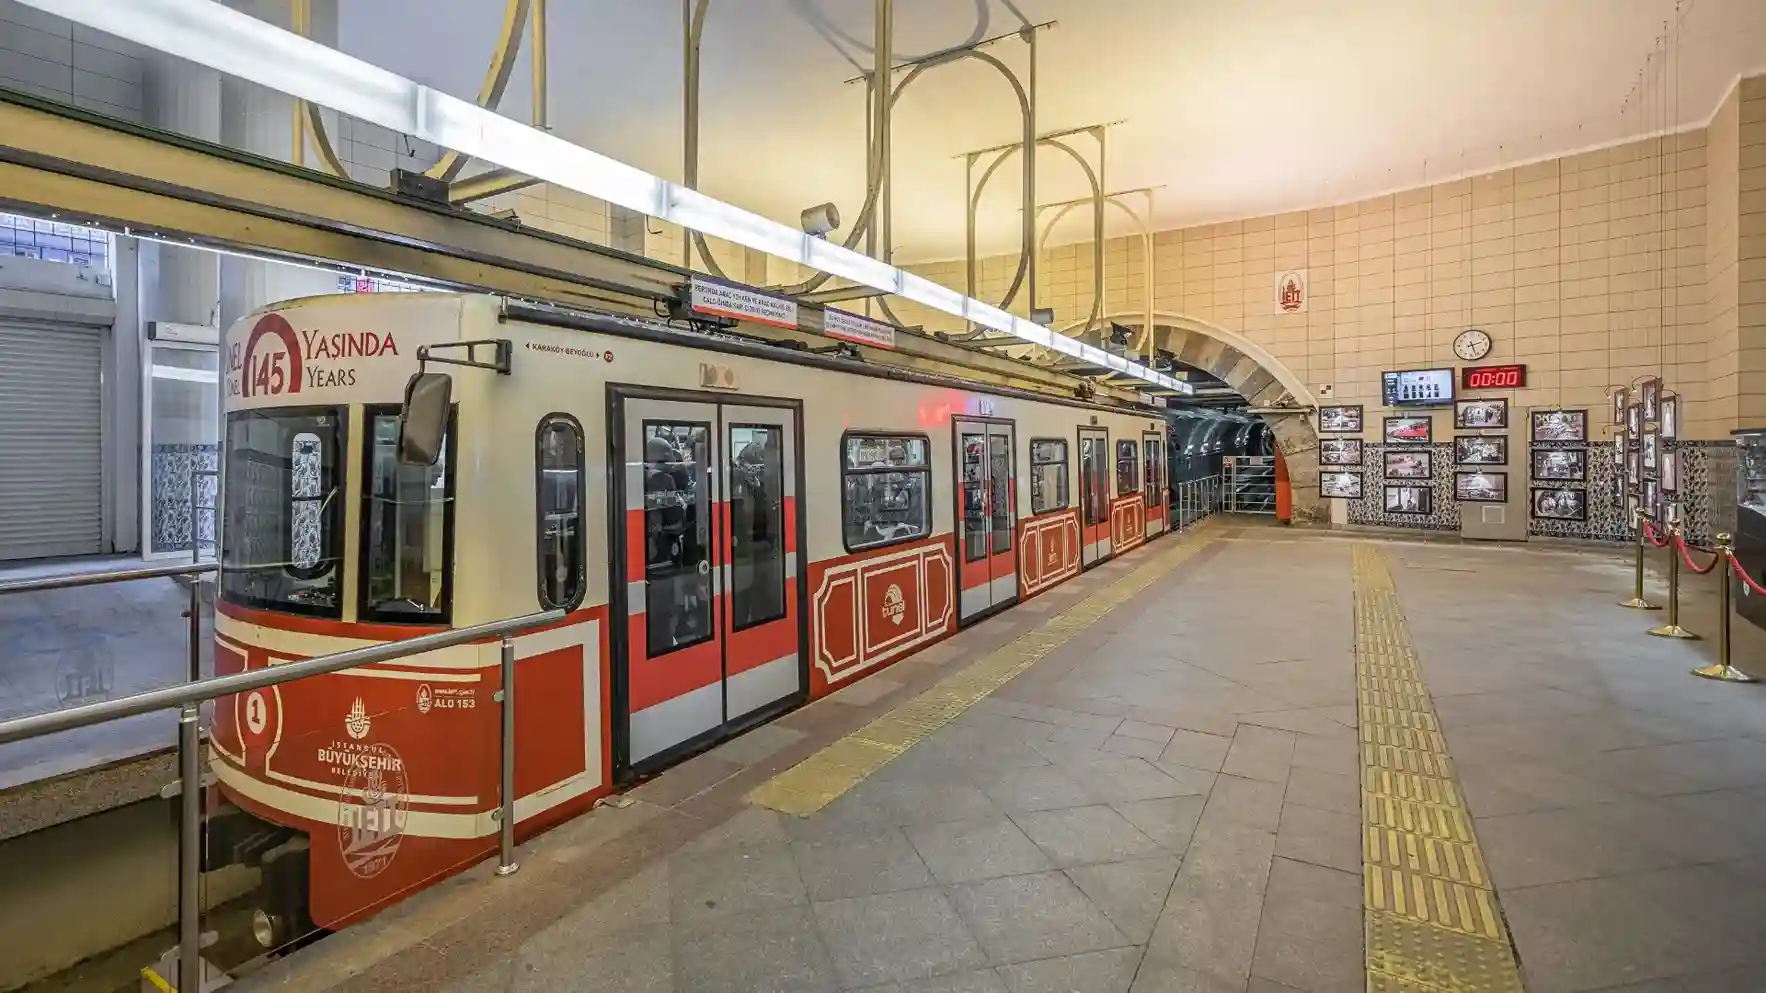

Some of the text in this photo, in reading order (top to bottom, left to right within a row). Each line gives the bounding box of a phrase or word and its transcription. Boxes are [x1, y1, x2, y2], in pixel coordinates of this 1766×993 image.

[252, 351, 284, 397] 145
[301, 329, 399, 360] YAŞINDA
[306, 366, 356, 387] YEARS
[1470, 371, 1518, 387] 00:00
[251, 699, 260, 725] 1
[457, 699, 476, 708] 153
